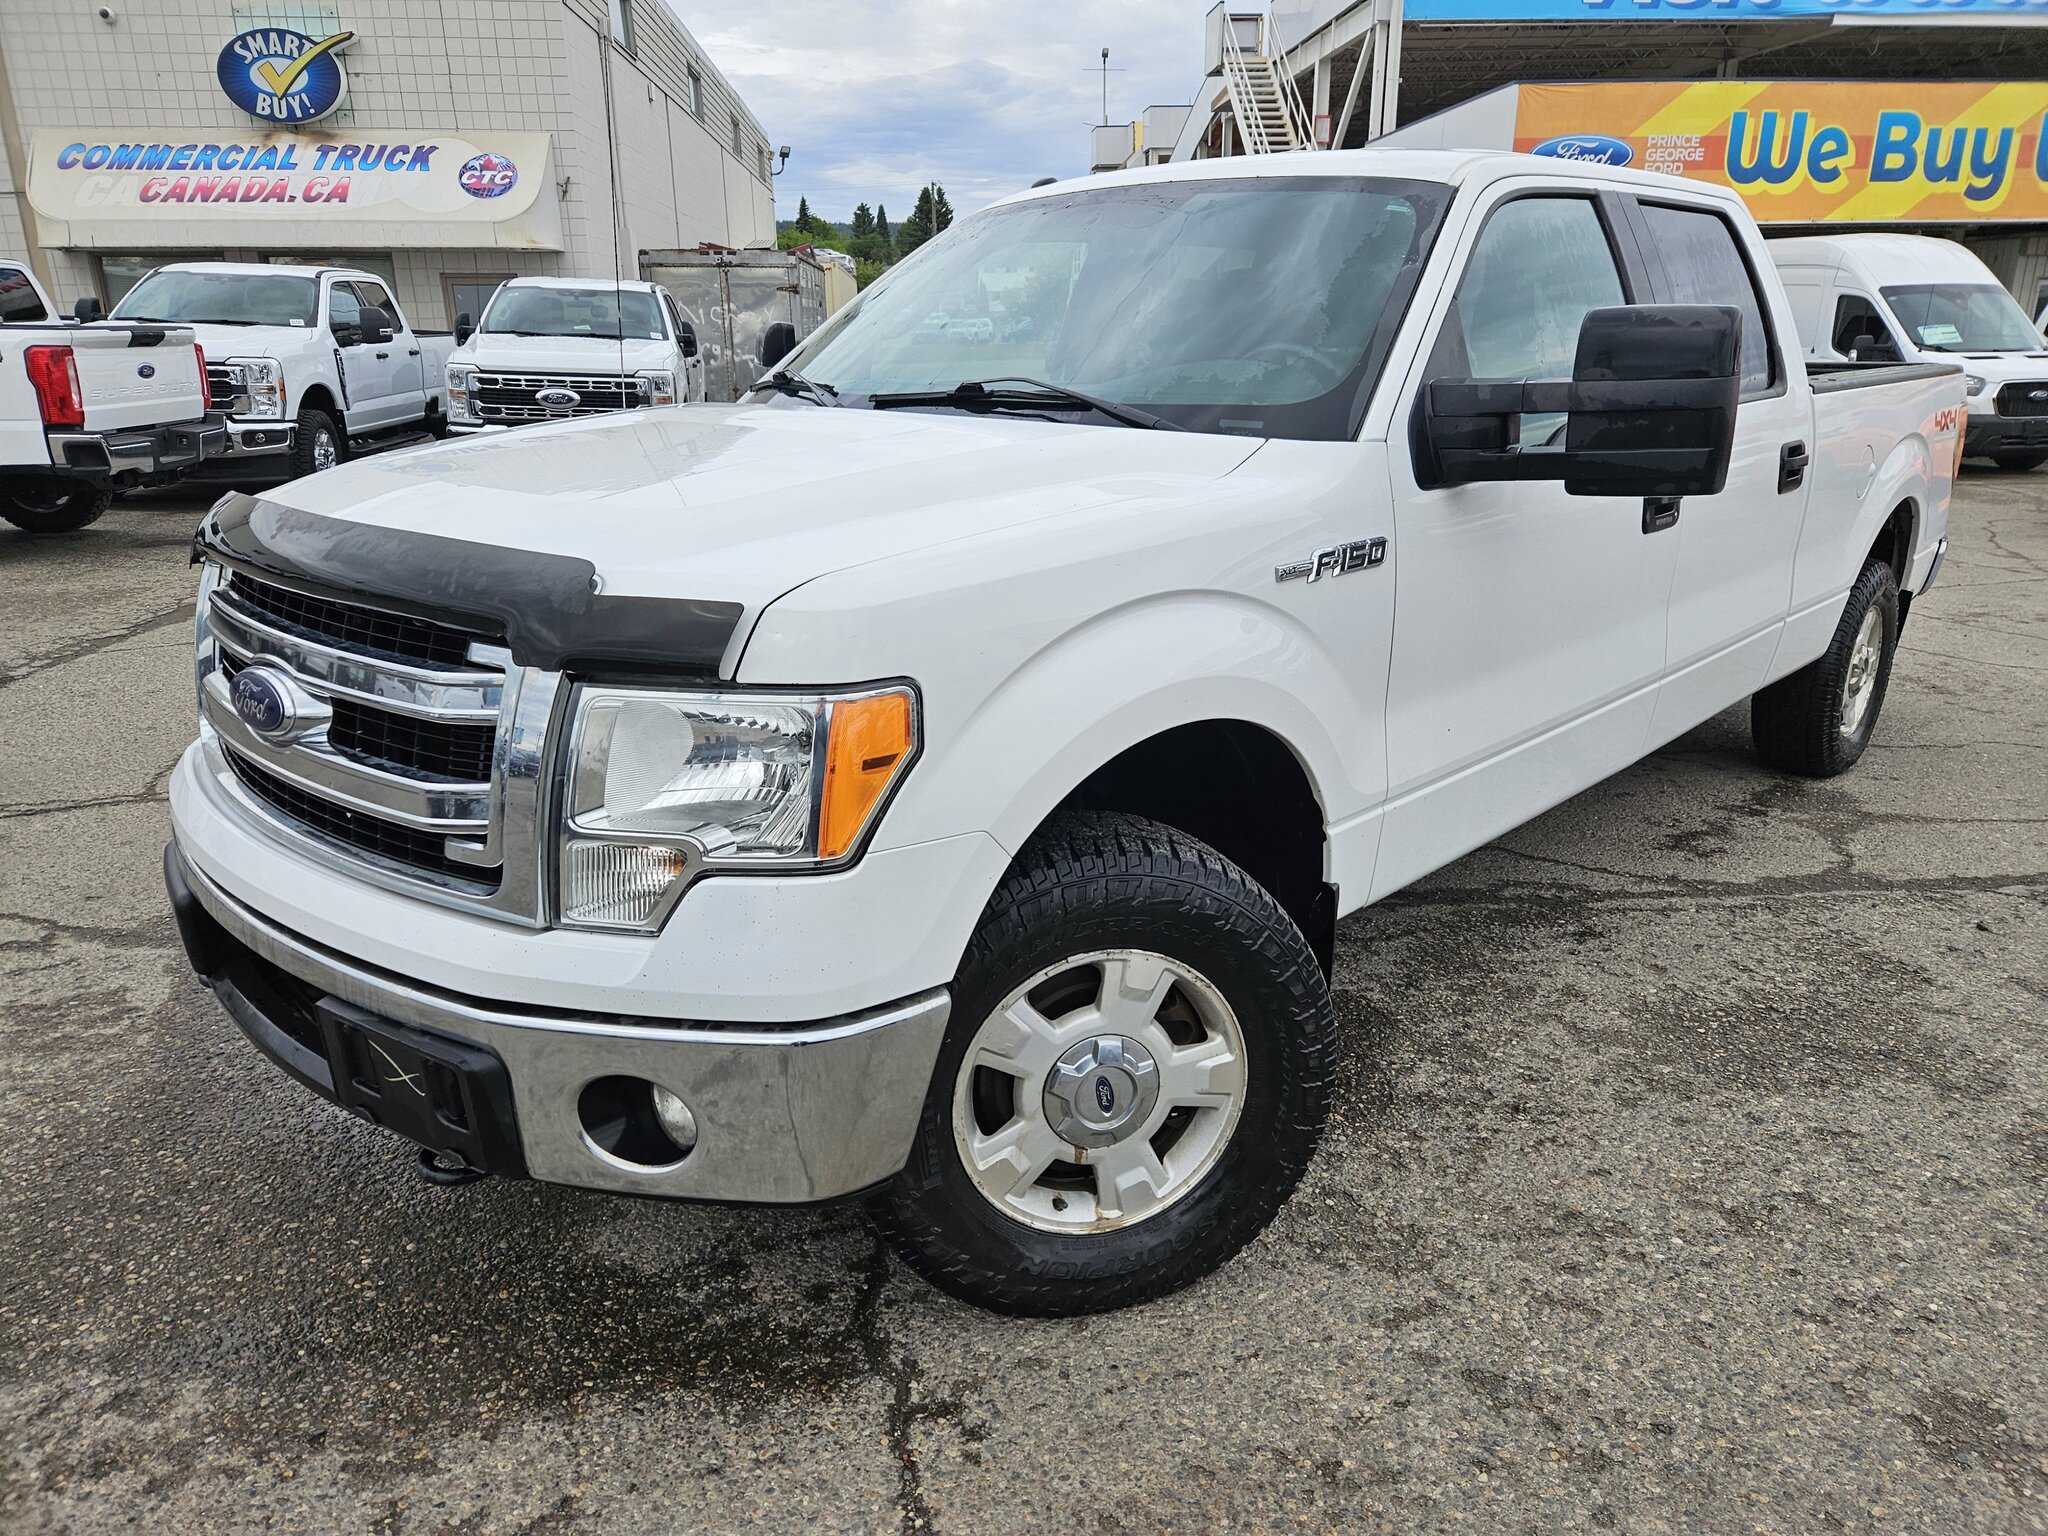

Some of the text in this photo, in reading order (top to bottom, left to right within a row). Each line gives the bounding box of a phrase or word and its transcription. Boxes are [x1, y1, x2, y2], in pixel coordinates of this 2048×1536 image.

[233, 31, 314, 65] SMART
[255, 92, 316, 119] BUY!
[1647, 134, 1701, 147] PRINCE
[56, 142, 440, 172] COMMERCIAL TRUCK
[1645, 148, 1705, 161] GEORGE
[1726, 111, 1849, 185] We
[1868, 111, 2015, 202] Buy
[461, 170, 513, 185] CTC
[1644, 162, 1684, 175] FORD
[138, 176, 352, 204] CANADA.CA
[90, 381, 199, 399] SUPER DUTY
[546, 392, 568, 404] Ford
[1307, 536, 1388, 584] F-150
[235, 678, 270, 720] Ford
[1098, 1084, 1112, 1107] Ford
[1014, 1213, 1219, 1281] SCORPION
